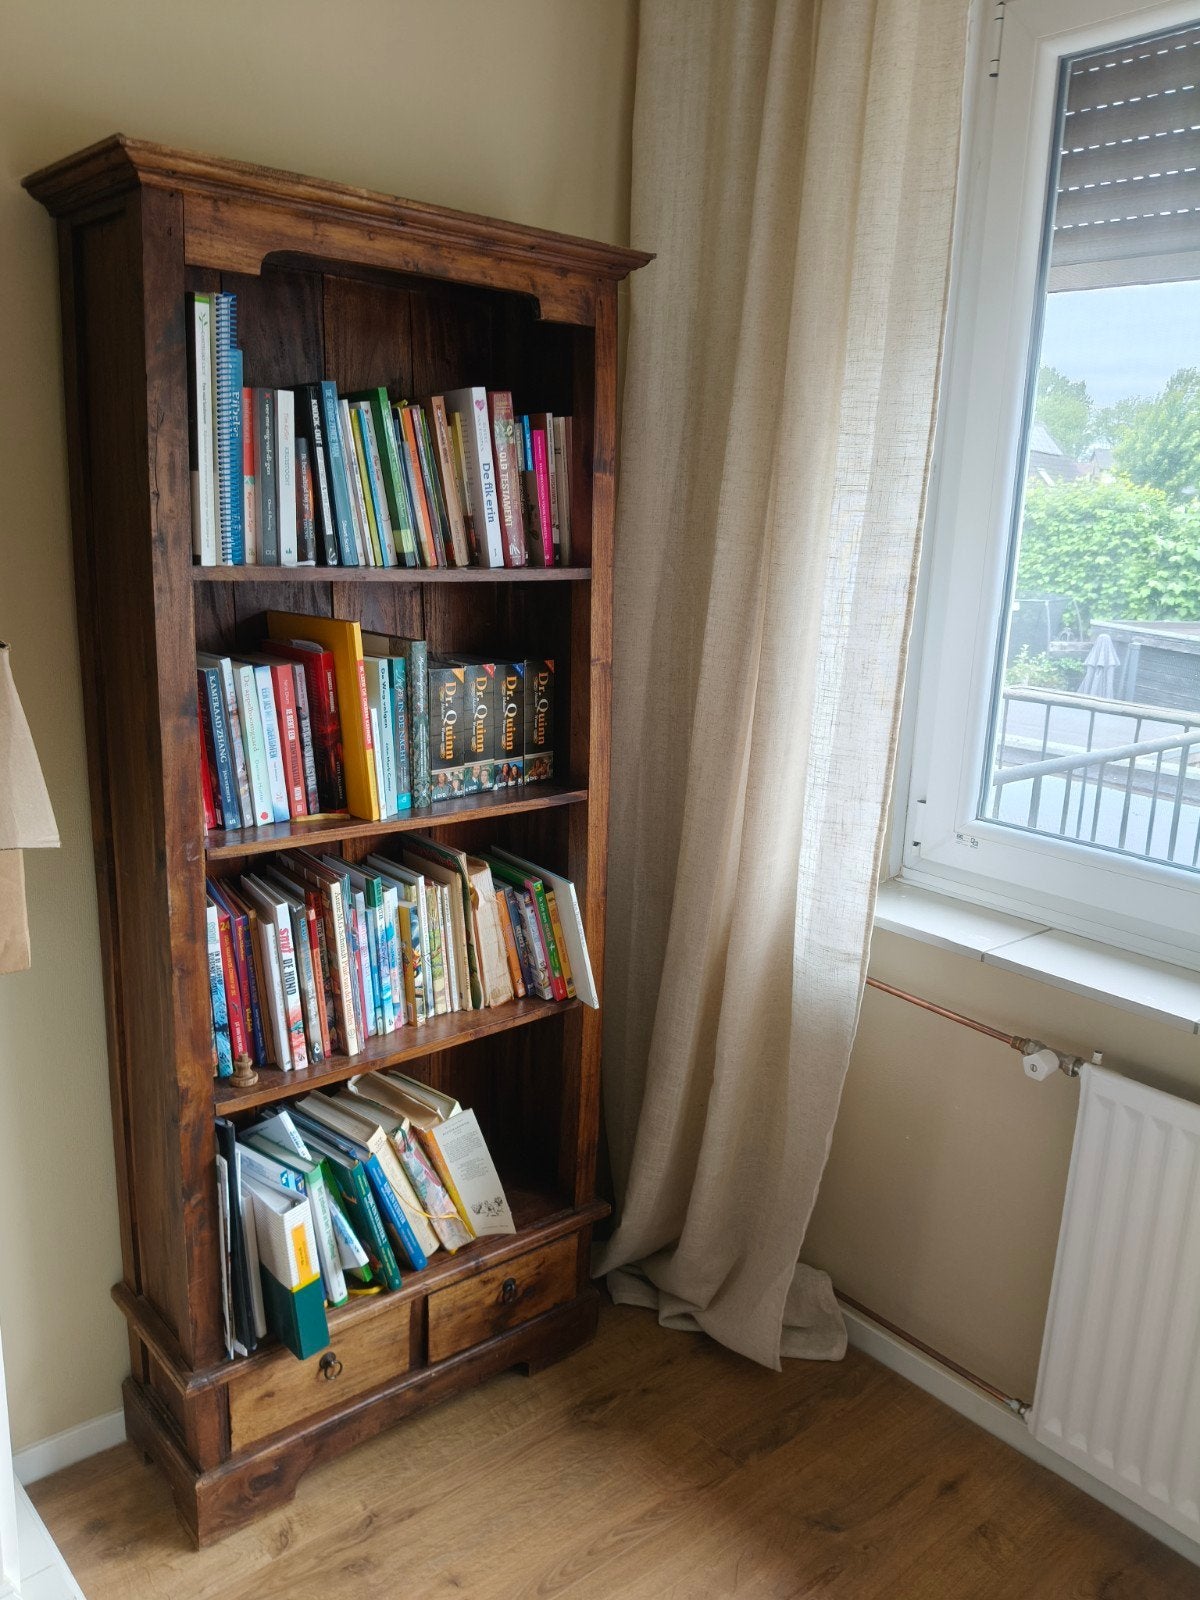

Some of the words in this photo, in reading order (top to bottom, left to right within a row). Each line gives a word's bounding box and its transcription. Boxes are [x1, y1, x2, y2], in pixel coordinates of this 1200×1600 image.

[310, 398, 322, 446] KNOCK-OUT
[299, 452, 307, 461] Ik
[300, 461, 308, 474] ben
[498, 450, 508, 470] OLD
[481, 461, 491, 479] De
[300, 474, 309, 493] altijd
[483, 480, 494, 497] fik
[484, 498, 496, 523] erin
[500, 472, 512, 528] TESTAMENT
[340, 519, 349, 537] Stuart
[342, 536, 351, 553] Scott
[242, 674, 250, 688] De
[380, 667, 386, 680] De
[537, 671, 548, 696] Dr.
[444, 680, 456, 706] Dr.
[475, 676, 487, 701] Dr.
[505, 675, 517, 701] Dr.
[208, 675, 223, 728] KAMERAAD
[397, 701, 403, 712] IN
[243, 688, 259, 752] appelboomgaard
[381, 701, 389, 729] volgen
[398, 714, 404, 728] DE
[503, 702, 517, 750] Quinn
[535, 697, 549, 745] Quinn
[300, 718, 312, 751] MANNEN
[442, 709, 457, 759] Quinn
[473, 704, 488, 752] Quinn
[215, 728, 228, 763] ZHANG
[398, 729, 406, 763] NACHT
[304, 751, 314, 767] VAN
[306, 767, 317, 791] STAAL
[333, 890, 342, 913] Annie
[538, 901, 546, 911] zie
[298, 916, 309, 941] KLEUR
[337, 930, 347, 959] Schmidt
[281, 957, 293, 969] DE
[340, 959, 349, 977] Pluk
[283, 970, 297, 996] HOND
[344, 990, 351, 999] de
